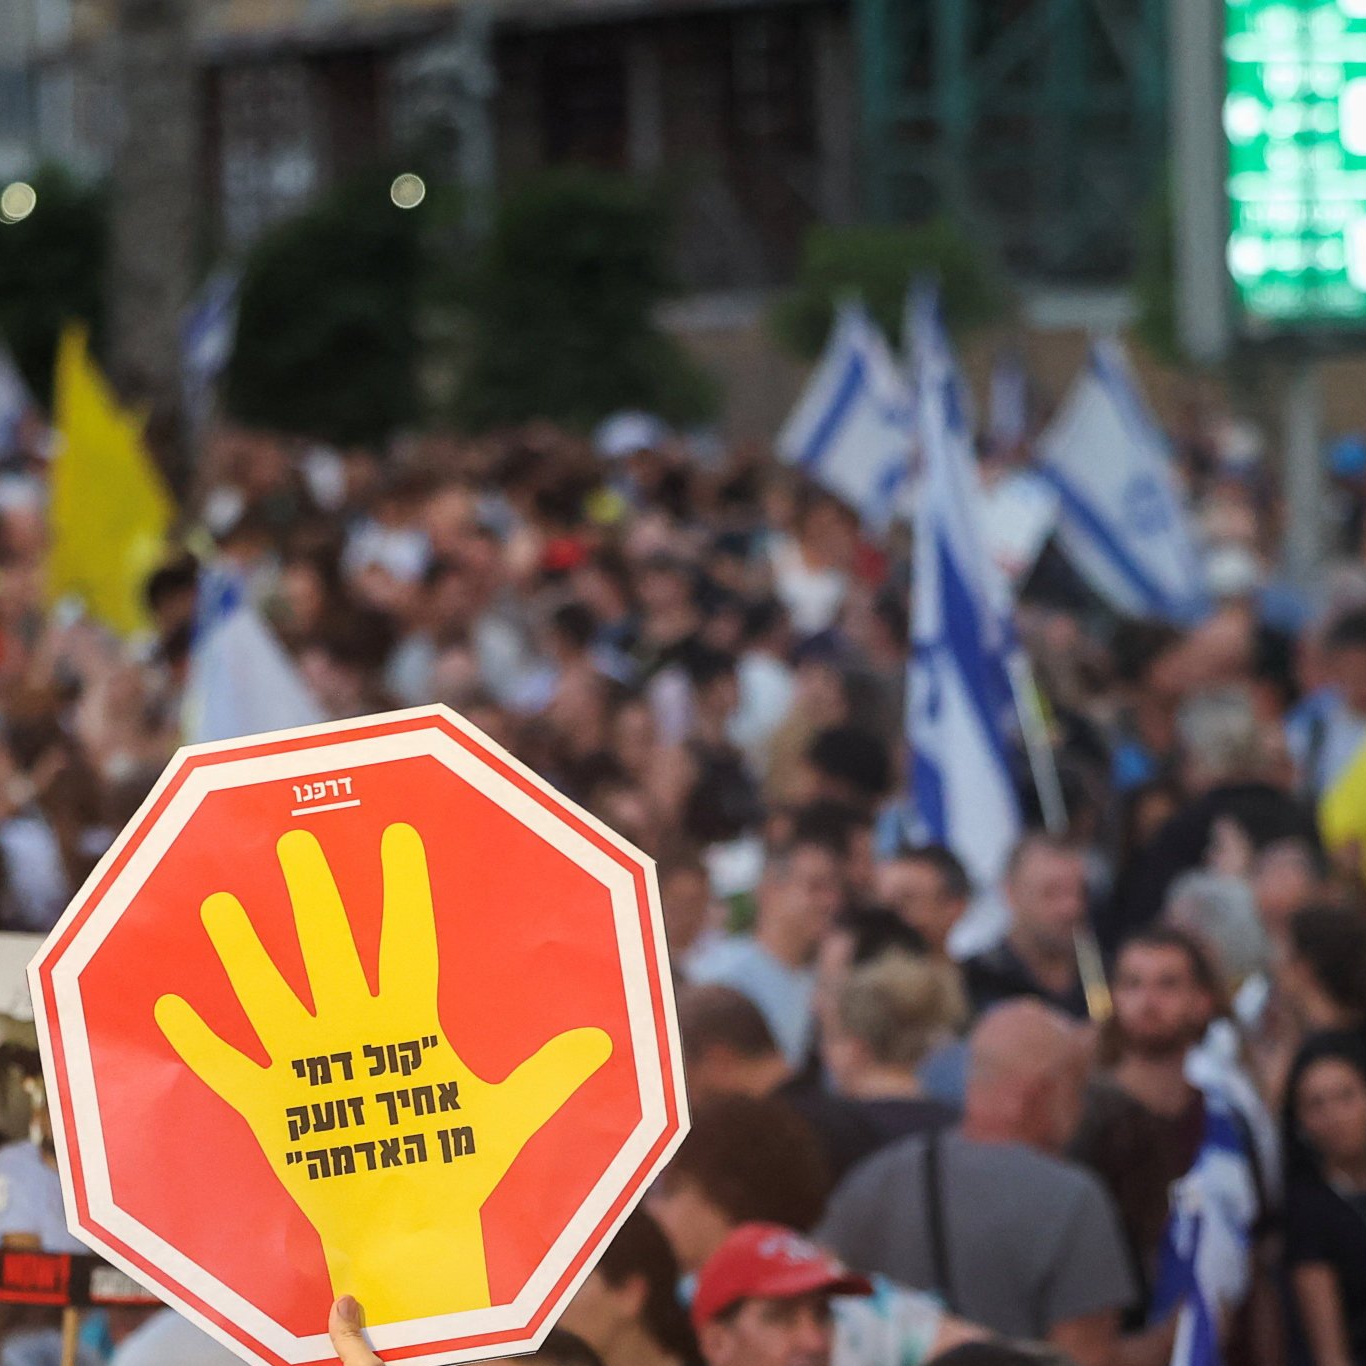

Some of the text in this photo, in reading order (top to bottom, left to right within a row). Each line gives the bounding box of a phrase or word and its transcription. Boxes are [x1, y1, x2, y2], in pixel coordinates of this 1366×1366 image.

[291, 1051, 354, 1087] דמי
[285, 1081, 461, 1142] אחיך זועק
[437, 1126, 476, 1164] מן
